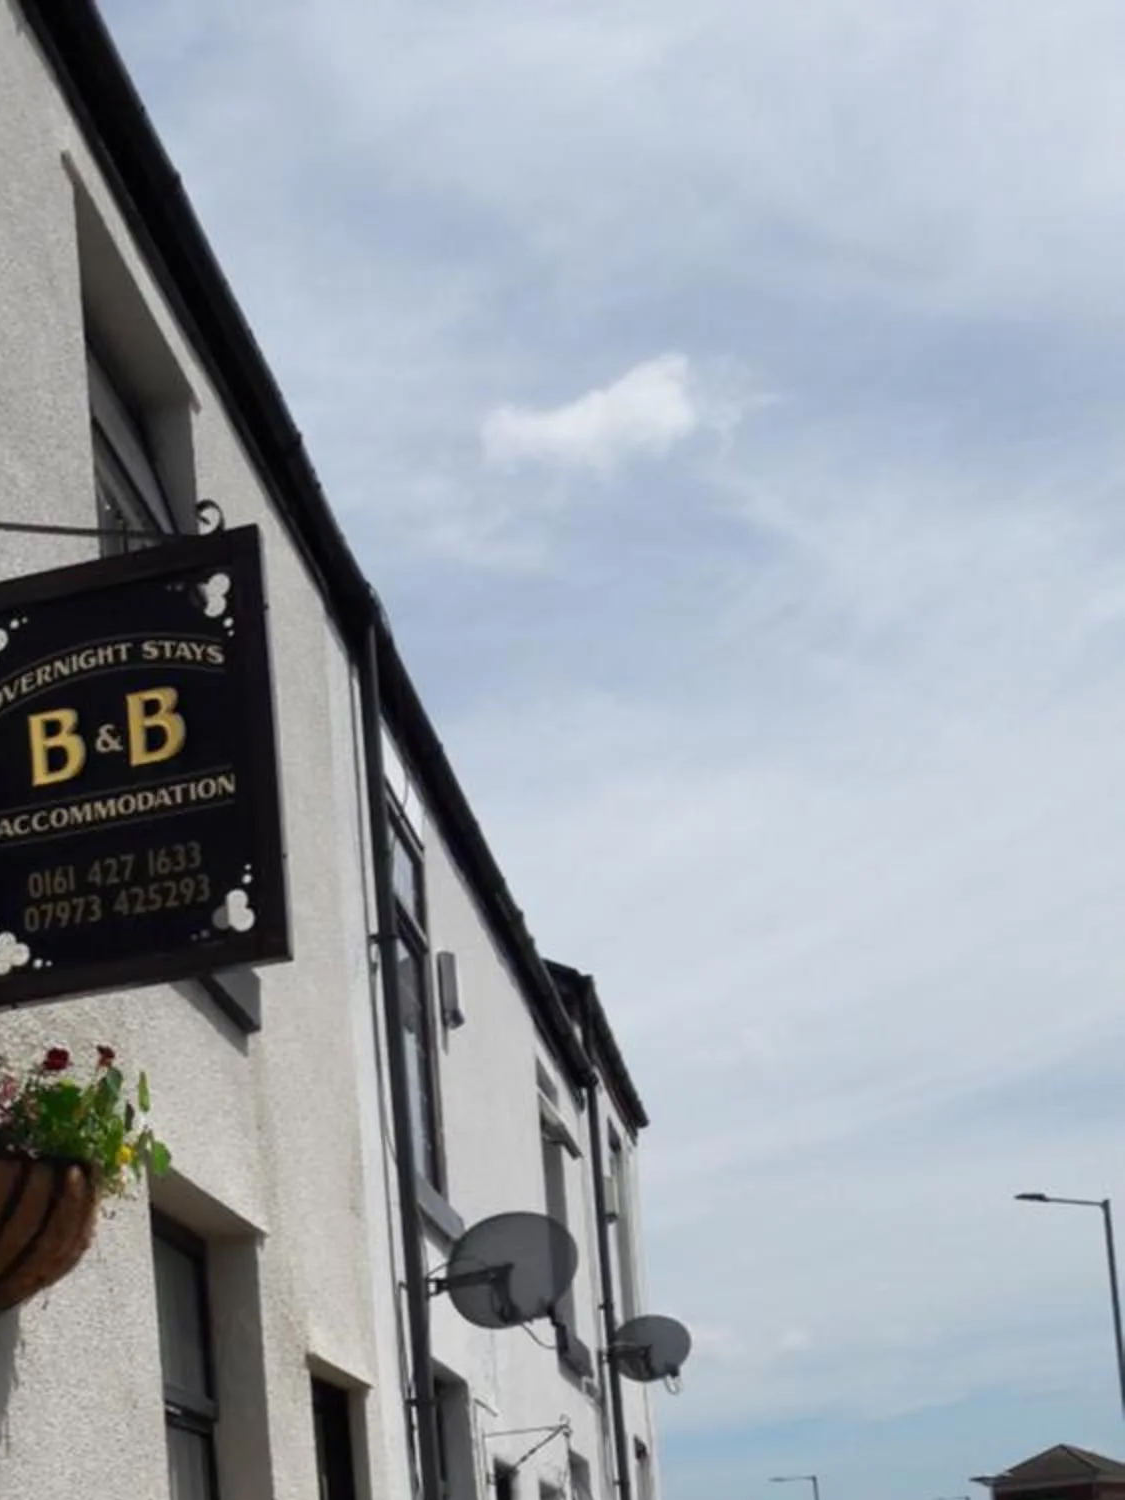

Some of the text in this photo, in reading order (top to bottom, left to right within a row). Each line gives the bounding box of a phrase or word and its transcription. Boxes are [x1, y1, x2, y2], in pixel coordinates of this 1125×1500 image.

[141, 640, 225, 665] STAYS
[28, 840, 202, 898] 0161 427 1633
[24, 874, 211, 932] 07973 425293
